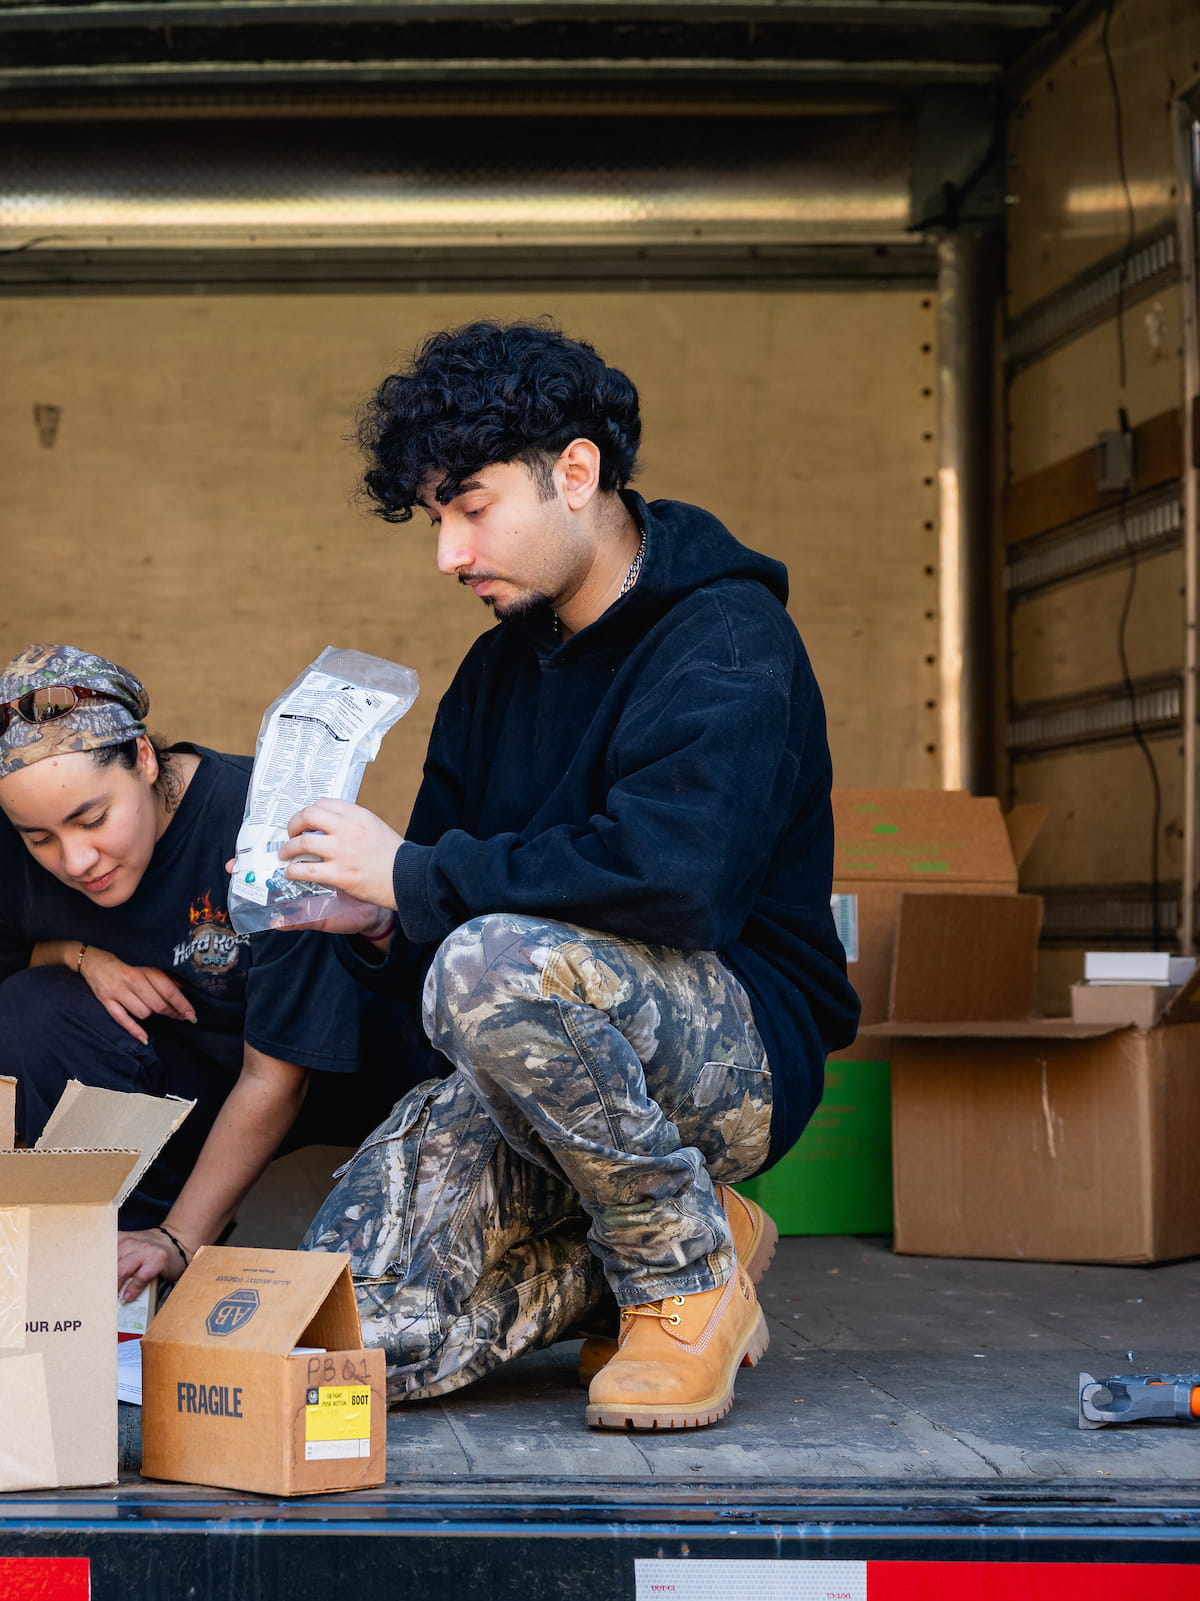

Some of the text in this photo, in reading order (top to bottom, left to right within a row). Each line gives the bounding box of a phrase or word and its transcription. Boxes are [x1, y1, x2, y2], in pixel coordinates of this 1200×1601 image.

[173, 932, 211, 967] Hard
[202, 955, 228, 966] CAFE
[53, 1320, 82, 1332] APP
[177, 1382, 243, 1418] FRAGILE
[351, 1395, 369, 1406] 800T
